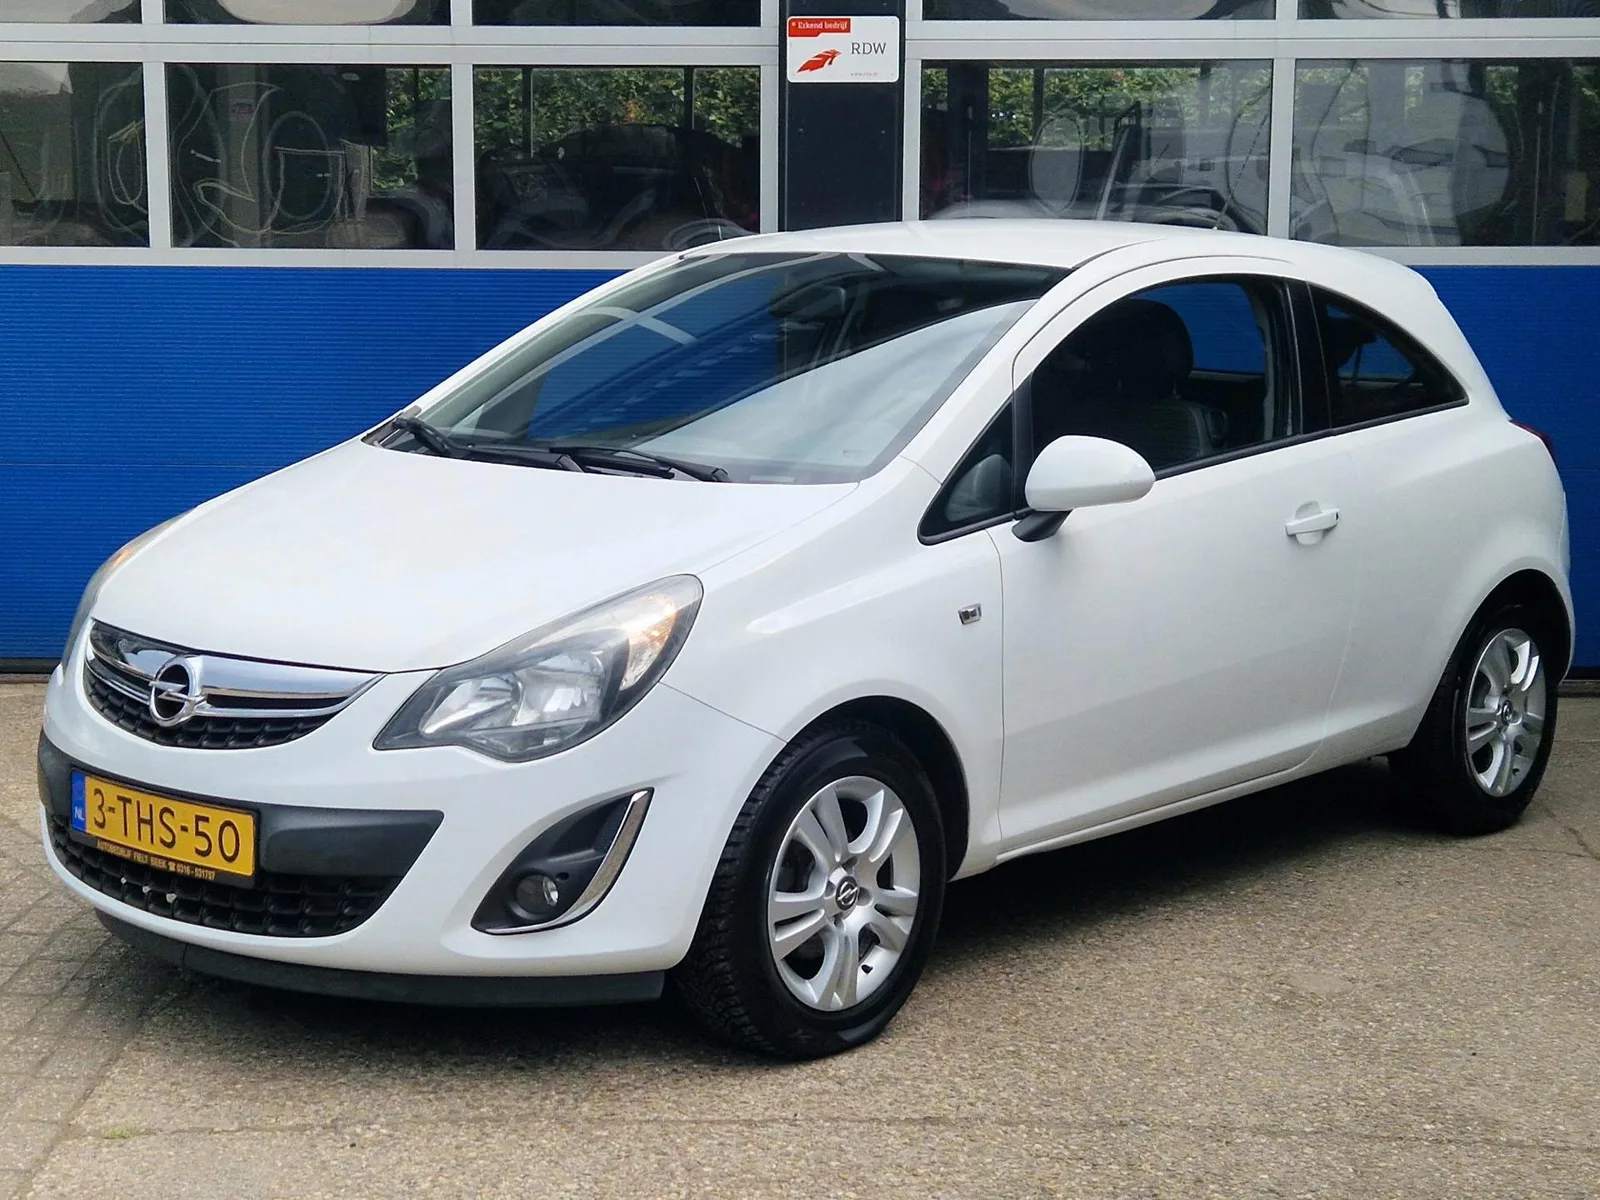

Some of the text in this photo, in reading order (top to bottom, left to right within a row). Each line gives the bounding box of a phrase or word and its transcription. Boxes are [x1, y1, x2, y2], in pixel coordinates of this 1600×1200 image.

[797, 21, 848, 30] Erkend bedrijf
[851, 42, 887, 55] RDW
[74, 807, 85, 820] NL
[93, 788, 240, 863] 3-THS-50
